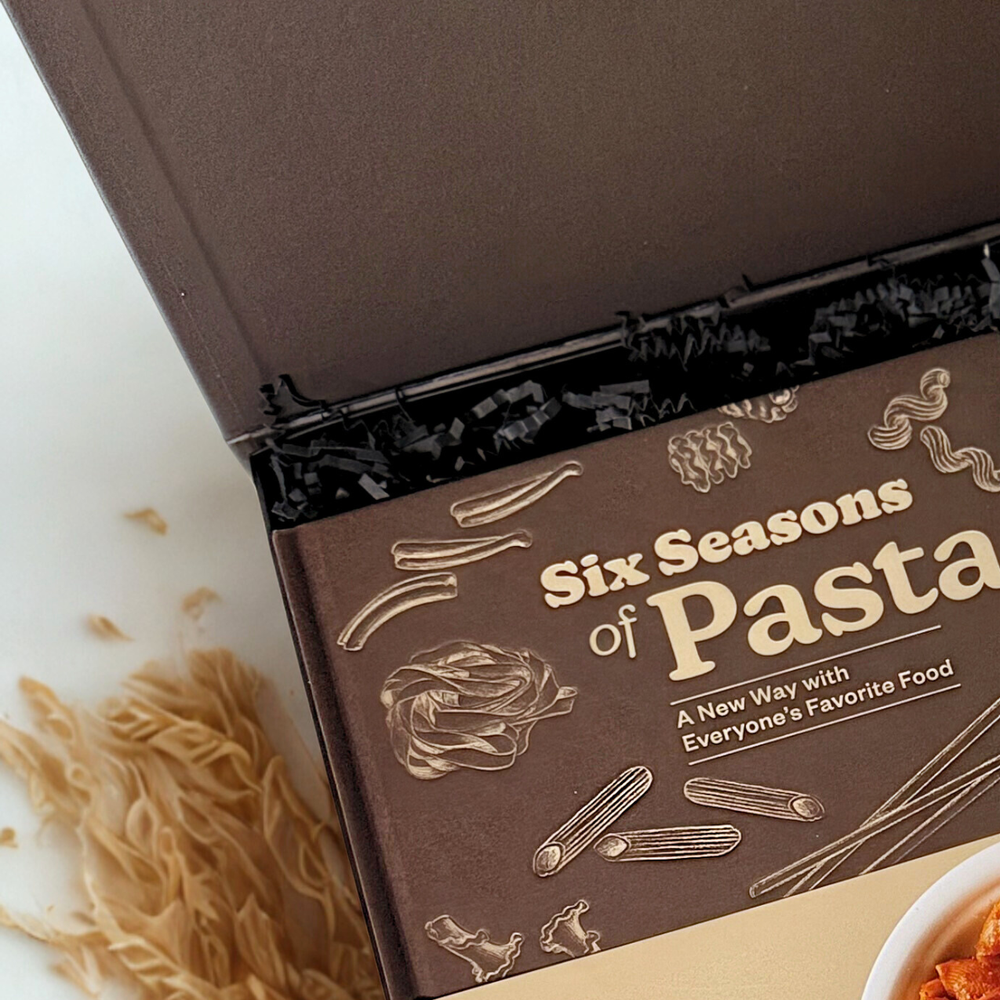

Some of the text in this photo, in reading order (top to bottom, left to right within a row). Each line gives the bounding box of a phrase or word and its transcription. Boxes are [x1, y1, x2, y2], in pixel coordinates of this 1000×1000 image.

[540, 479, 913, 608] Six Seasons
[589, 605, 637, 658] of
[677, 665, 850, 728] A New Way with
[806, 681, 895, 716] Favorite
[898, 659, 954, 689] Food
